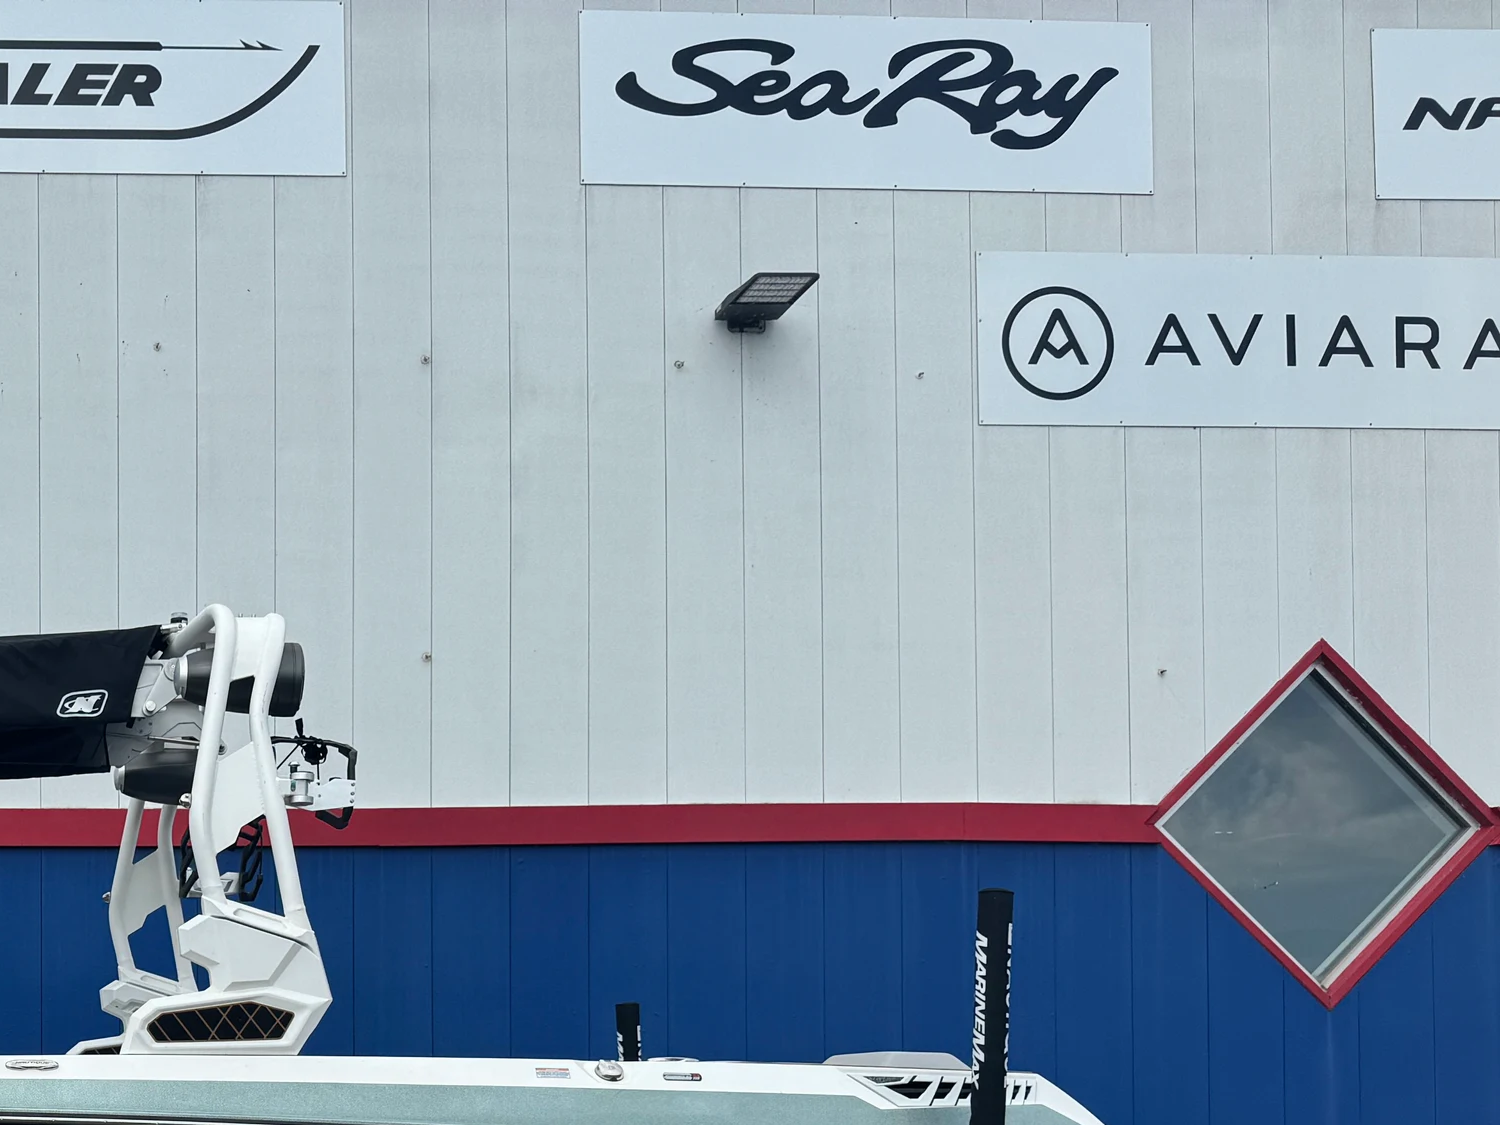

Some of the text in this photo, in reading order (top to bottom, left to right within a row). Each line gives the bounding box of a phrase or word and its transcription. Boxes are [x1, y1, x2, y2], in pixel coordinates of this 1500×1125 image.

[615, 38, 1120, 150] Sea Ray
[1144, 313, 1500, 370] AVIARA
[971, 930, 988, 1090] MARINEMAX
